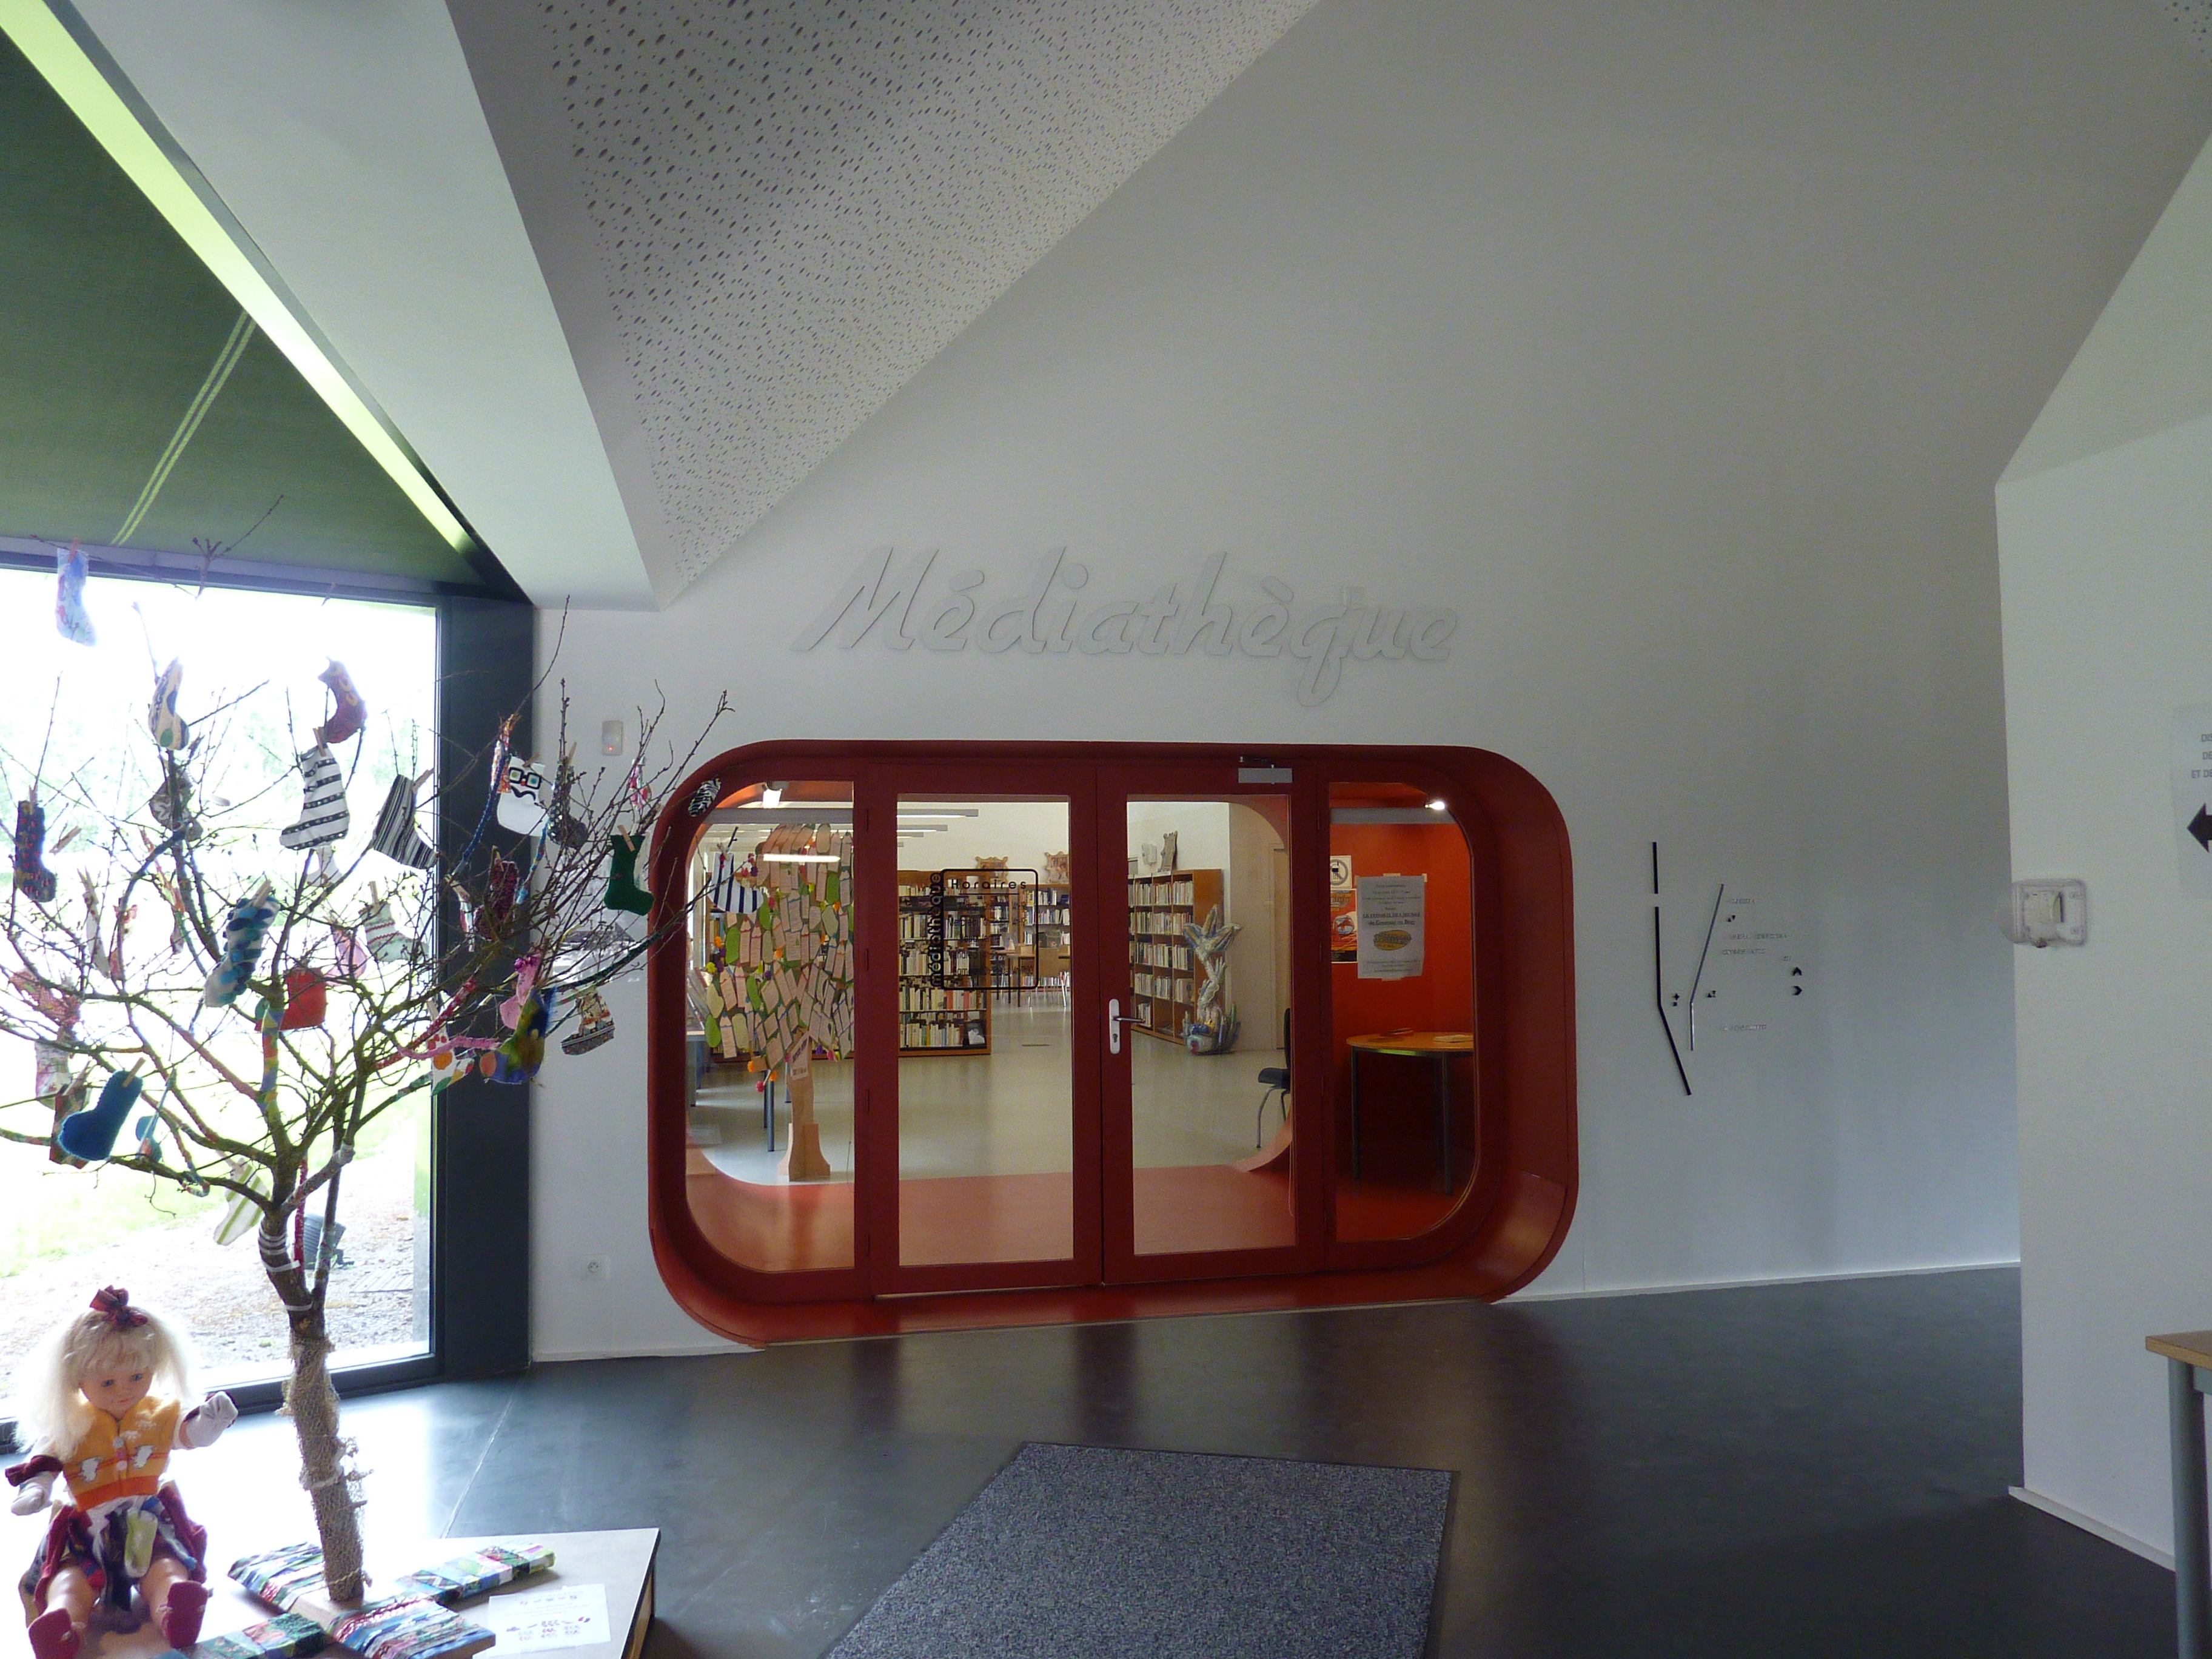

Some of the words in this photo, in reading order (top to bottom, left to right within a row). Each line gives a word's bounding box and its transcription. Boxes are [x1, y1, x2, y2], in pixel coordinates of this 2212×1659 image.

[789, 546, 1457, 708] Médiathèque
[2191, 770, 2200, 779] ET
[951, 879, 1027, 890] Horaires
